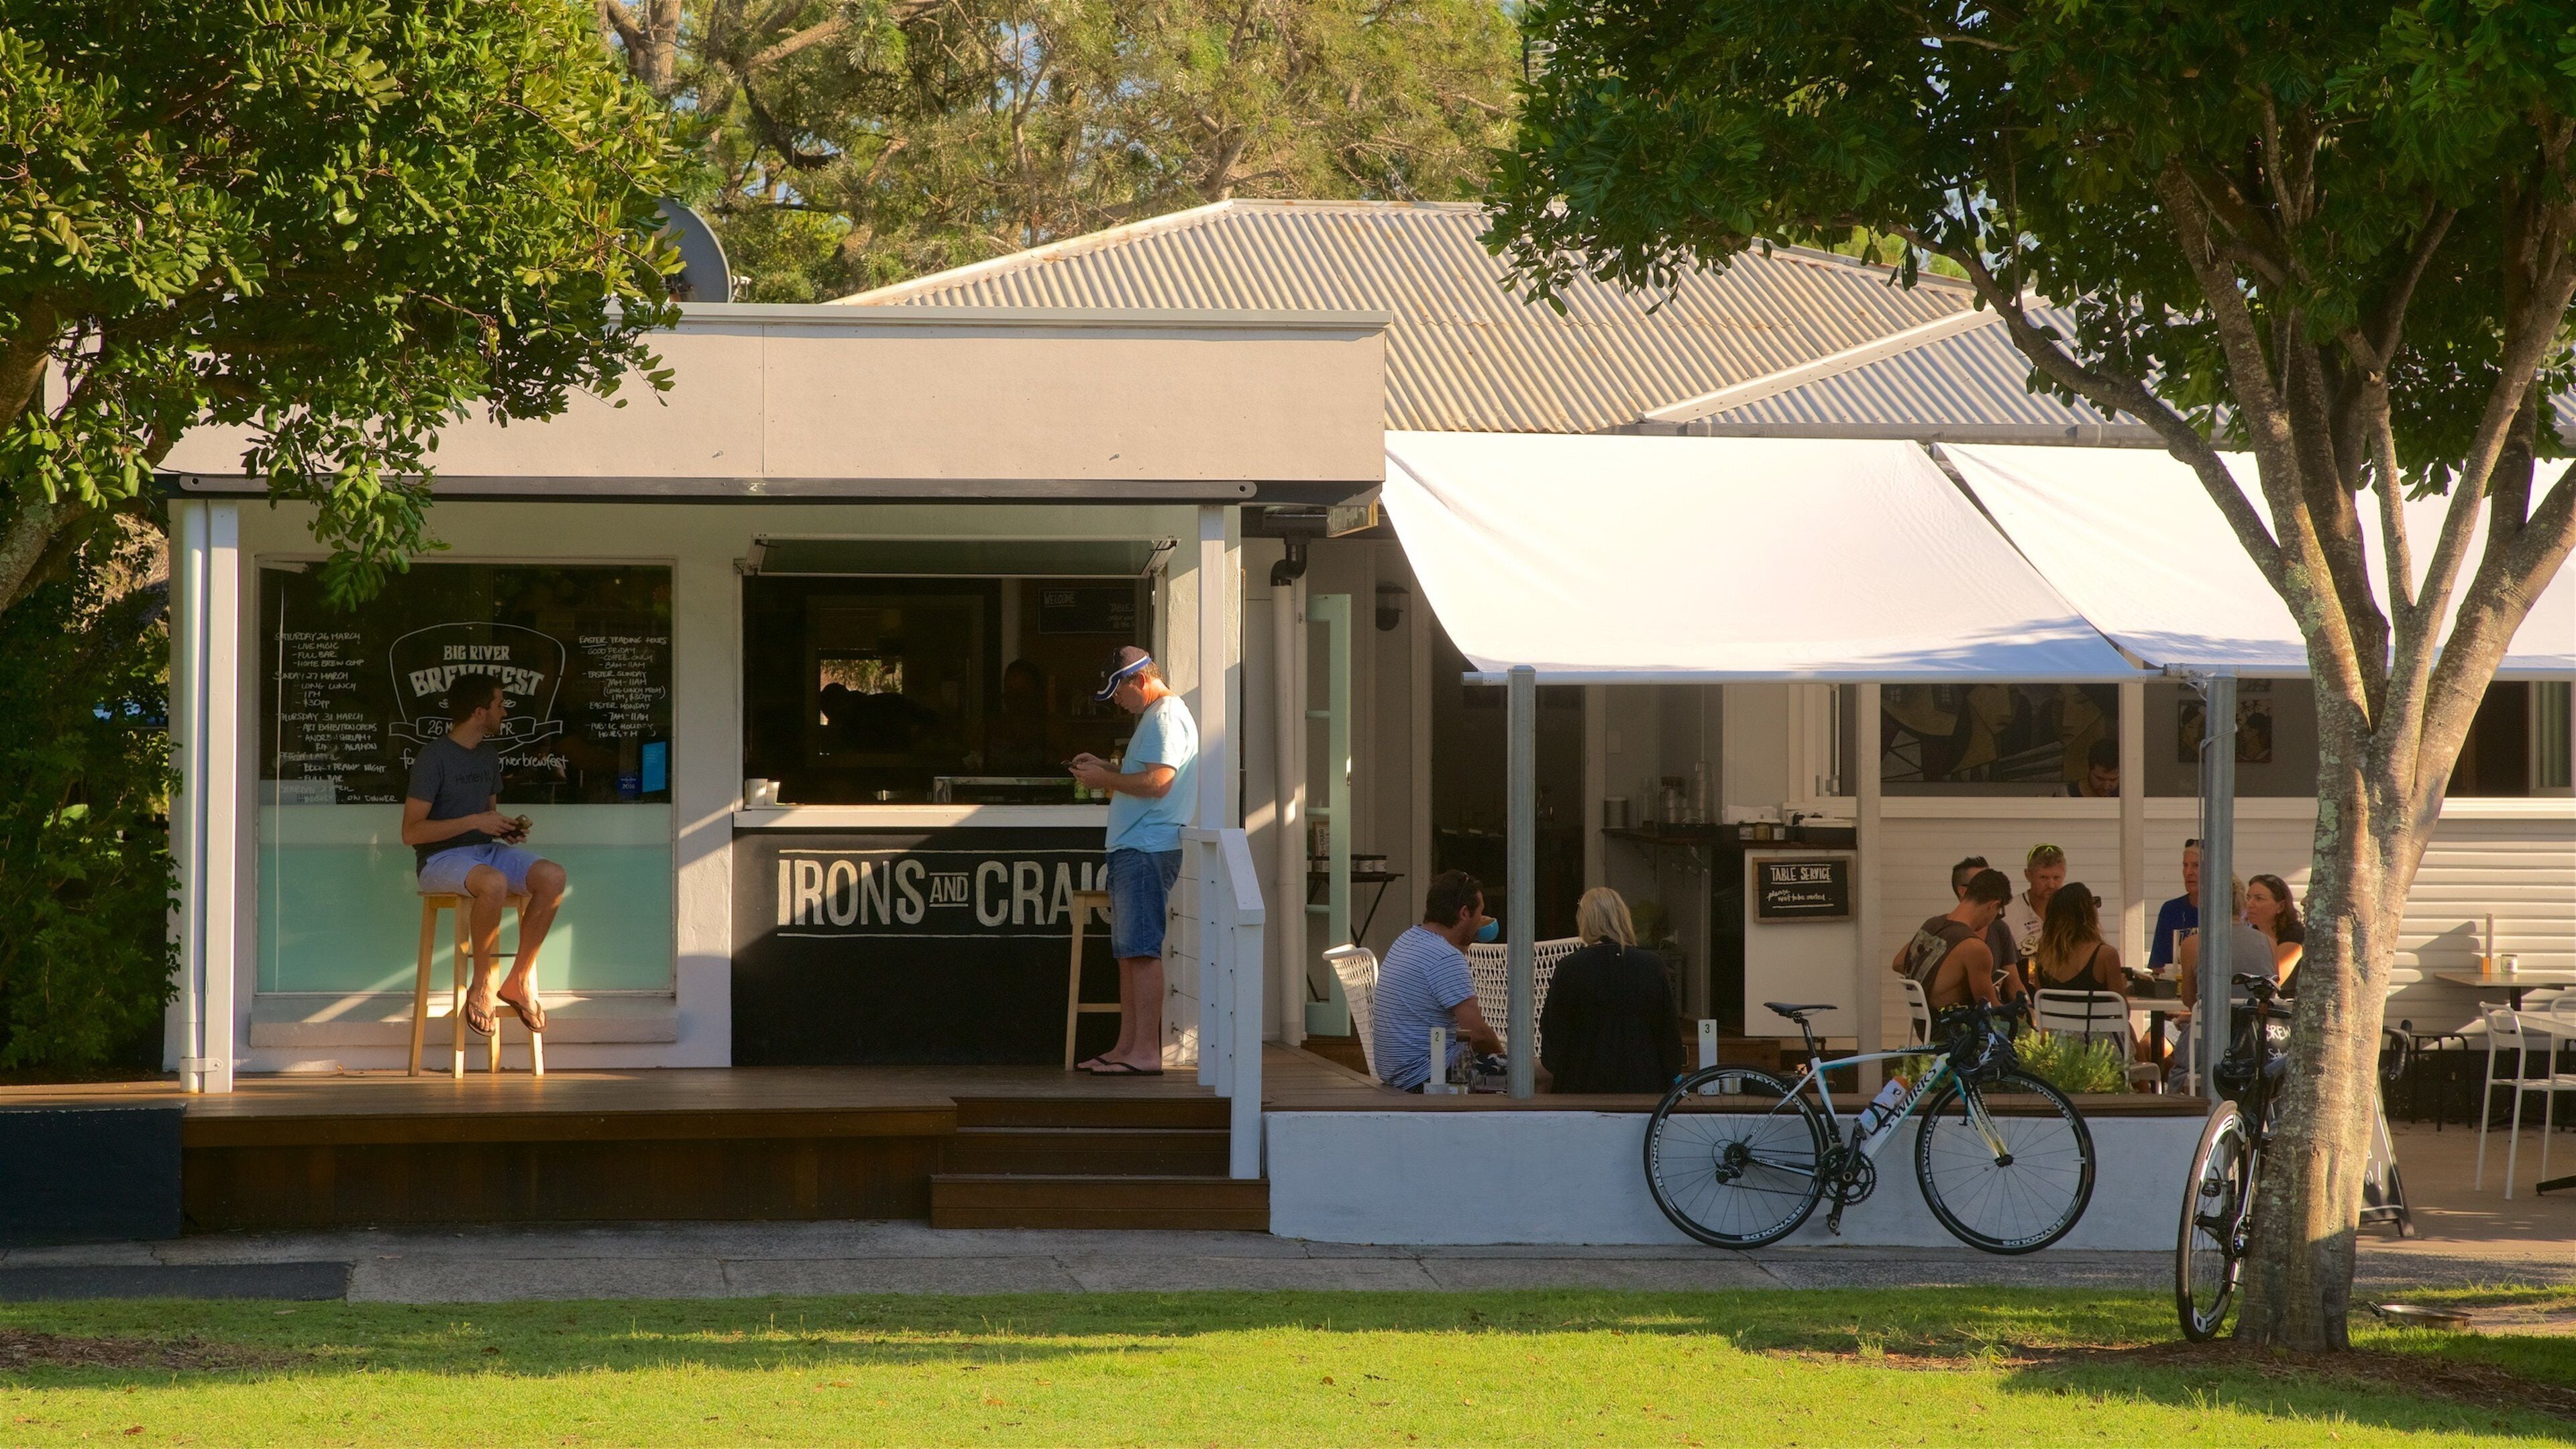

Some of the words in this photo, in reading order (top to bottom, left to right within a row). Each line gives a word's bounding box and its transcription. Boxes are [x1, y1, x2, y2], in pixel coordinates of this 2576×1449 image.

[1109, 602, 1134, 613] TABLE
[579, 635, 608, 644] EASTER
[608, 636, 642, 645] TRADING
[645, 637, 667, 645] HOURS
[443, 645, 466, 661] BIG
[469, 645, 511, 661] RIVER
[320, 672, 349, 680] MARCH
[616, 671, 647, 679] SUNDAY
[589, 701, 619, 710] EASTER
[336, 712, 364, 722] MARCH
[427, 719, 444, 736] 26
[498, 751, 570, 772] griverbrewfest
[365, 794, 398, 803] DINNER
[1770, 867, 1797, 881] TABLE
[1800, 866, 1833, 881] SERVICE
[777, 859, 925, 928] IRONS
[929, 875, 968, 904] AND
[1435, 1031, 1440, 1042] 2
[1705, 1024, 1710, 1034] 3
[1745, 1073, 1806, 1114] REYNODS
[2019, 1079, 2074, 1127] REYNOLDS
[1652, 1118, 1666, 1188] REYNOLDS
[1922, 1114, 1940, 1183] REYNOLDS
[1741, 1205, 1805, 1241] REYNOLDS
[2002, 1218, 2064, 1246] REYNOLDS
